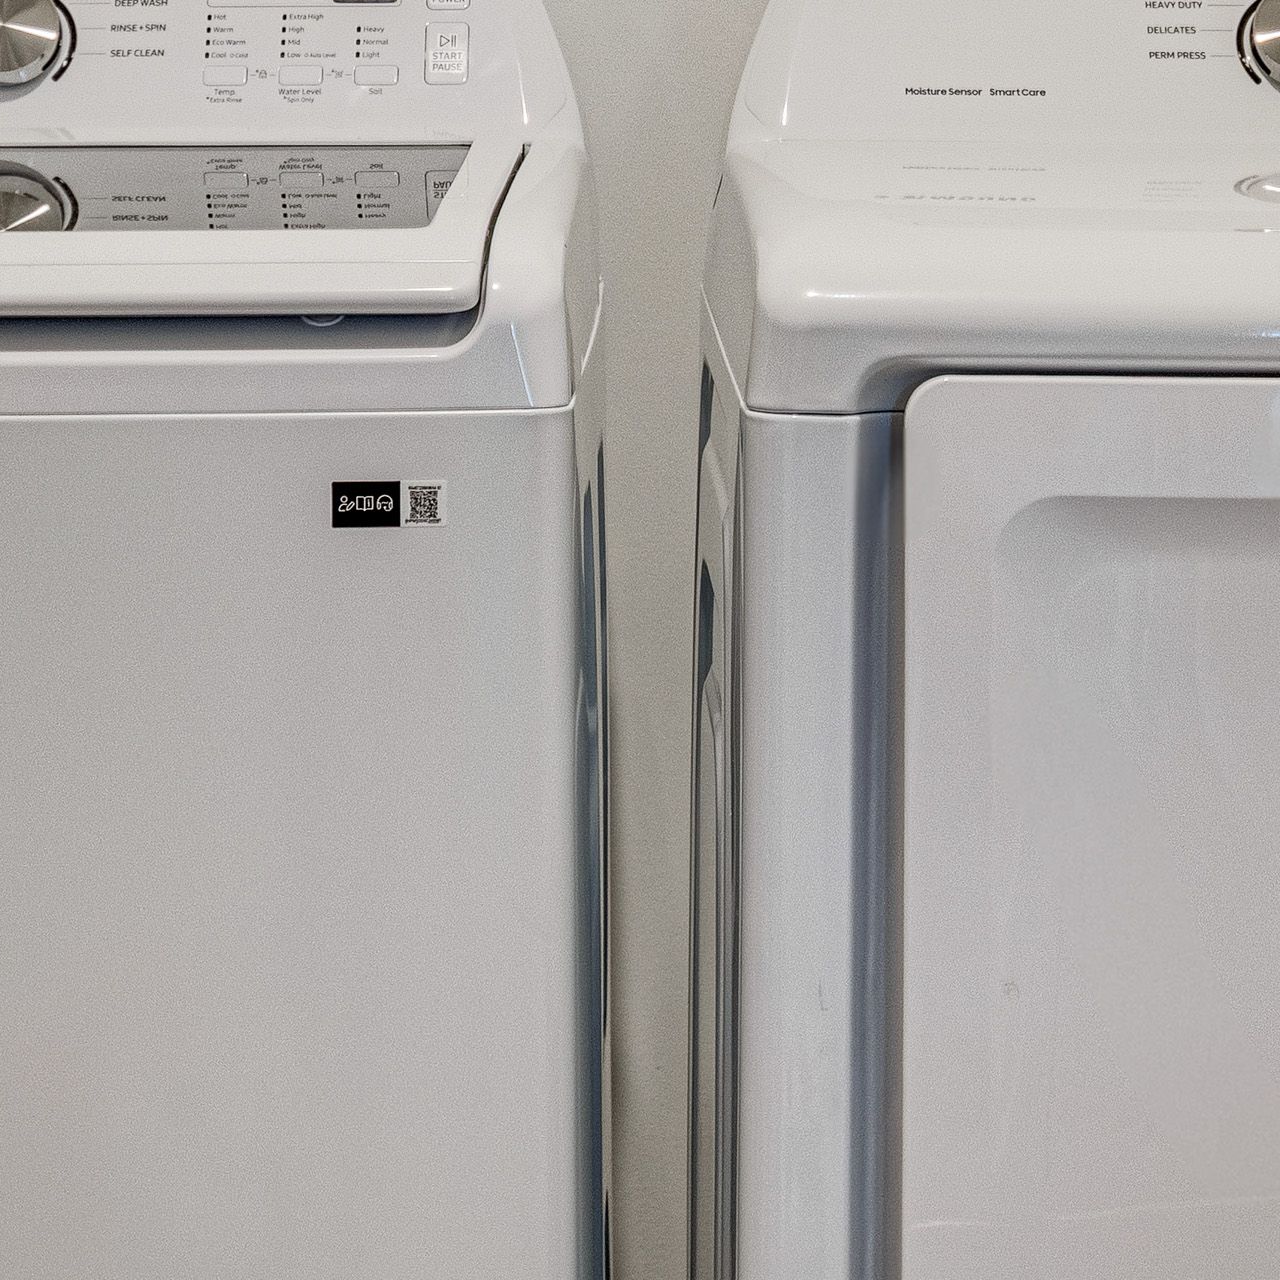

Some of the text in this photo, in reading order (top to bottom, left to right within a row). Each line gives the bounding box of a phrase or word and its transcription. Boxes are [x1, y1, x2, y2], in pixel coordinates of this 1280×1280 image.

[114, 0, 138, 8] DEEP
[1144, 1, 1203, 9] HEAVY DUTY
[308, 13, 324, 21] High
[110, 24, 136, 33] RINSE
[144, 23, 167, 32] SPIN
[288, 26, 305, 34] High
[1147, 26, 1197, 35] DELICATES
[110, 48, 165, 58] SELF CLEAN
[432, 52, 463, 60] START
[1149, 51, 1206, 60] PERM PRESS
[432, 63, 463, 72] PAUSE
[279, 88, 300, 96] Water
[905, 87, 947, 96] Moisture
[948, 87, 982, 96] Sensor
